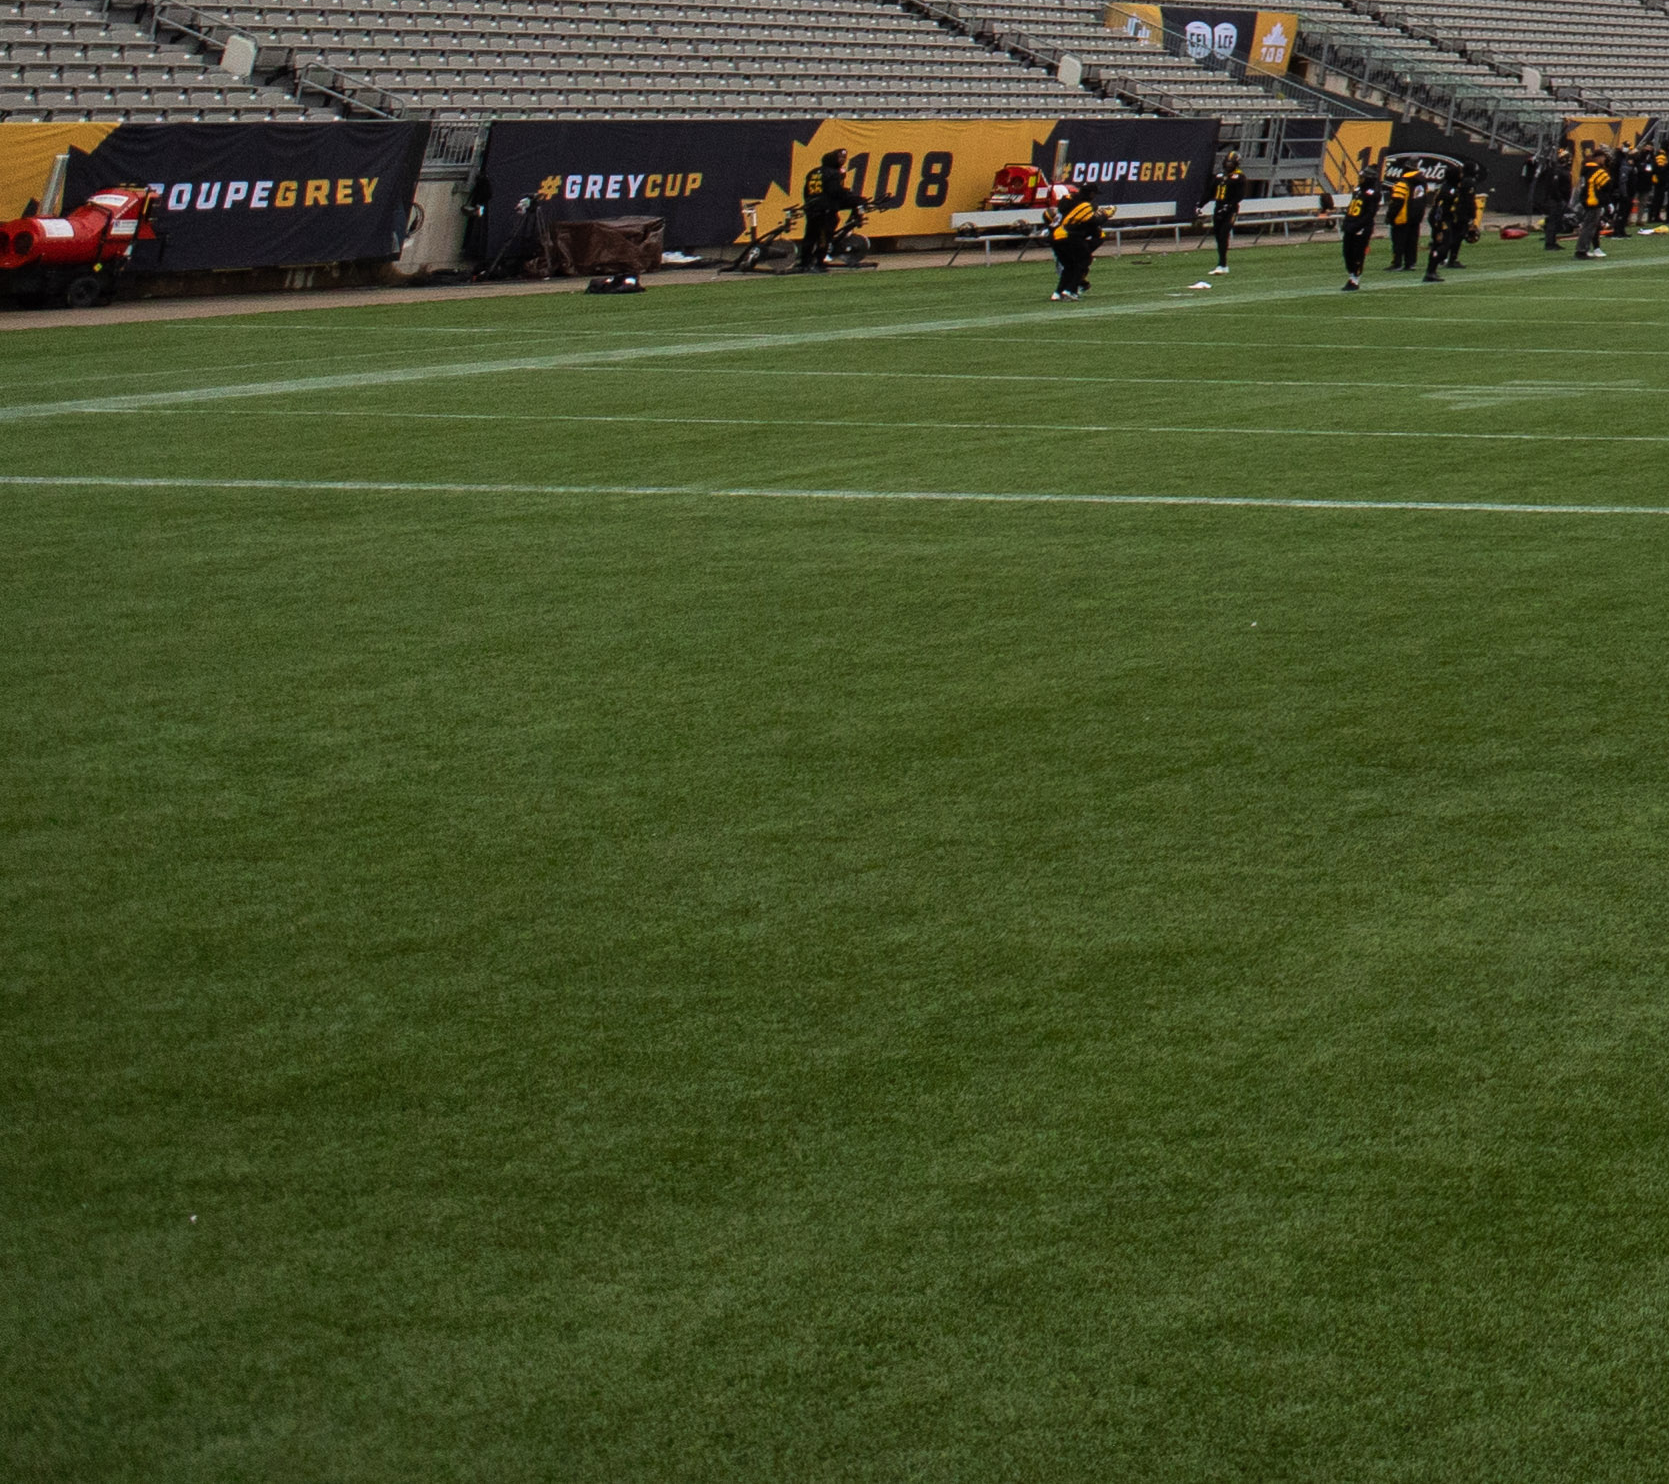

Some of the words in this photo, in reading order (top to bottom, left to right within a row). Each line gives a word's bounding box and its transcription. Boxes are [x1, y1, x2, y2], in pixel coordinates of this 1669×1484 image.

[1217, 33, 1234, 49] LCF
[1260, 46, 1285, 63] 108
[849, 150, 953, 210] 108
[1061, 160, 1192, 183] #COUPEGREY
[538, 172, 704, 201] #GREYCUP
